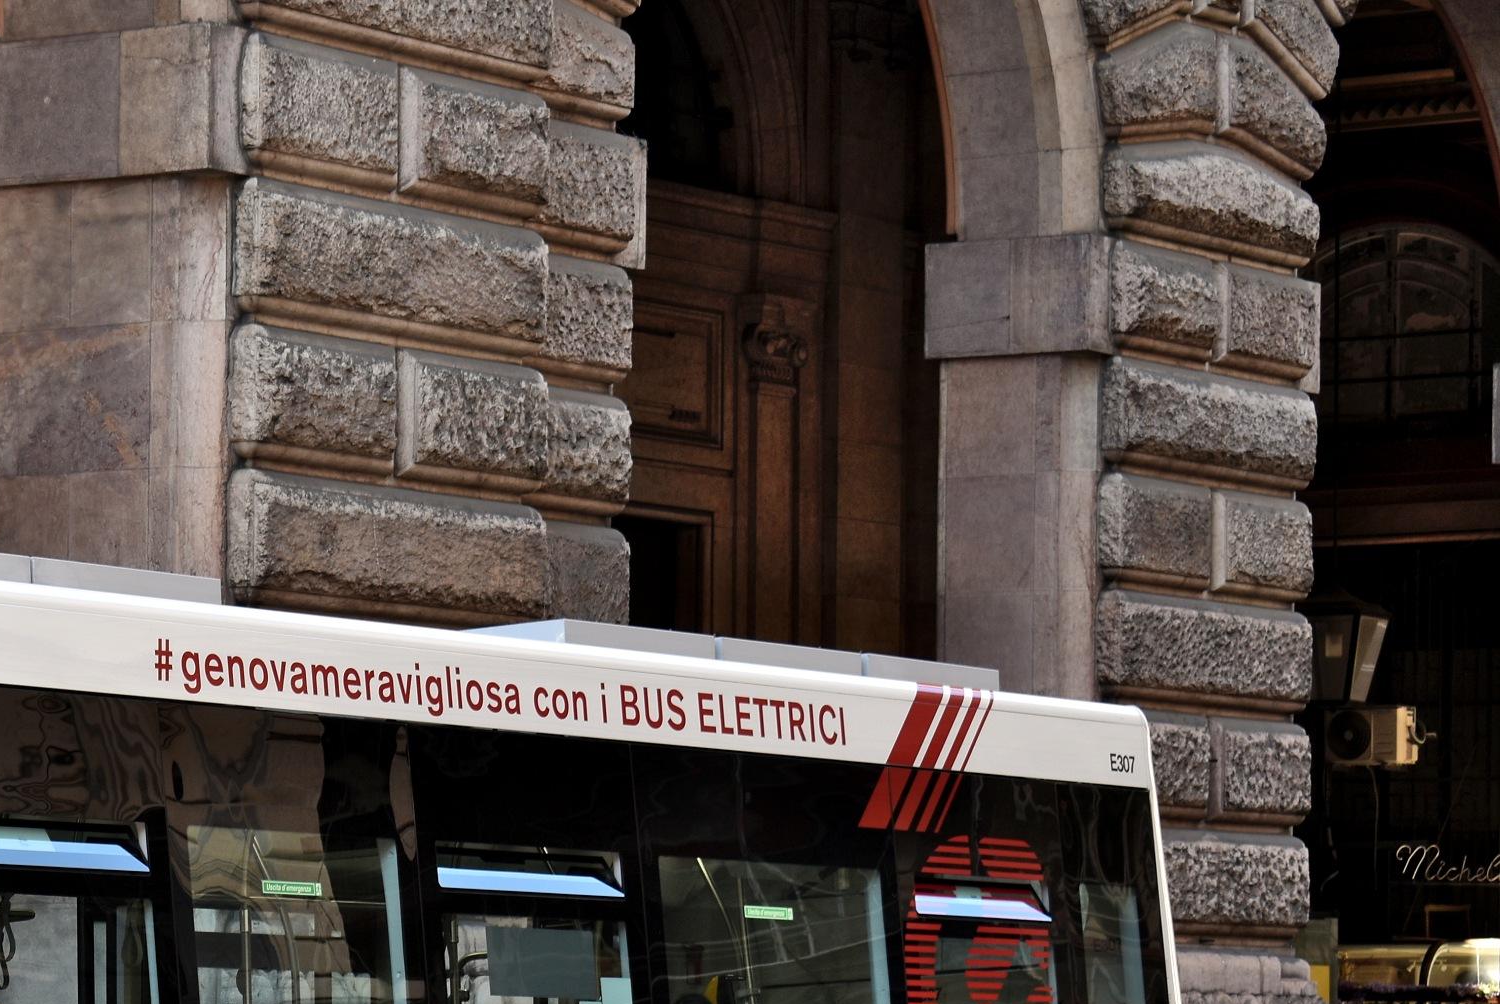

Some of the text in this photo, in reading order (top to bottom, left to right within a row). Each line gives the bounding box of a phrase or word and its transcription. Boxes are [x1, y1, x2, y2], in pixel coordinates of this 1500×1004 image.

[155, 638, 847, 746] #genovameravigliosa con i BUS ELETTRICI
[1109, 753, 1135, 774] E307
